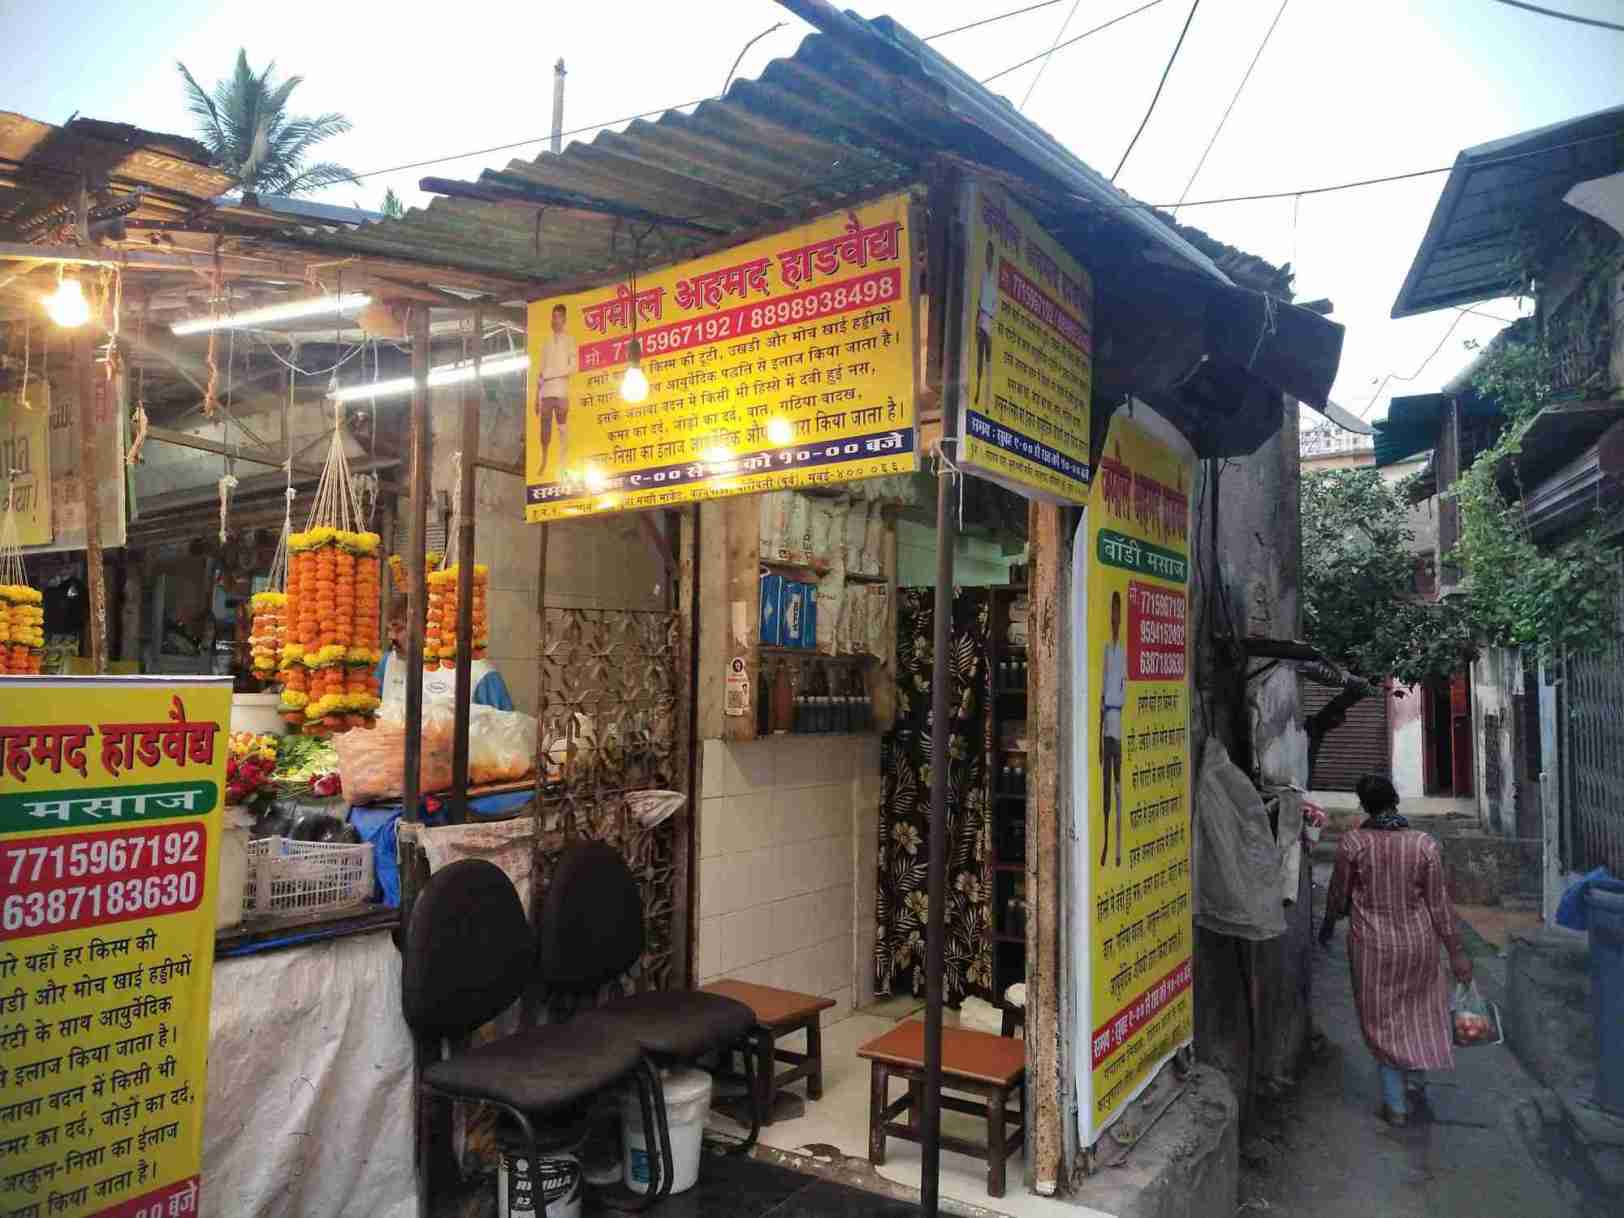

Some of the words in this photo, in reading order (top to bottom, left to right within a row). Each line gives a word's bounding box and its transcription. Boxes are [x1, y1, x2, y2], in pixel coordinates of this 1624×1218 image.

[674, 258, 773, 310] अहमद
[751, 276, 894, 329] 8898938498
[767, 332, 787, 348] और
[792, 326, 817, 342] मोच
[808, 345, 840, 361] किया
[845, 336, 877, 353] जाता
[851, 405, 882, 425] जाता
[866, 432, 904, 453] बजे
[1103, 534, 1142, 566] बॉडी
[1144, 549, 1185, 577] मसाज
[23, 789, 203, 821] मसाज
[7, 830, 199, 884] 7715967192
[3, 871, 196, 931] 6387183630
[25, 943, 58, 972] यहाँ
[64, 946, 84, 968] हर
[90, 937, 131, 961] किस्म
[136, 928, 157, 951] की
[34, 979, 67, 1006] और
[73, 973, 108, 998] मोच
[112, 963, 144, 991] खाई
[34, 1018, 53, 1044] के
[58, 1013, 93, 1037] साथ
[99, 993, 172, 1030] आयुर्वेदिक
[15, 1056, 63, 1088] इलाज
[68, 1044, 111, 1071] किया
[116, 1032, 153, 1057] जाता
[91, 1072, 105, 1097] में
[111, 1061, 152, 1093] किसी
[158, 1054, 177, 1078] भी
[35, 1125, 60, 1147] का
[64, 1110, 93, 1137] दर्द,
[144, 1092, 166, 1112] का
[111, 1135, 133, 1156] का
[48, 1186, 89, 1215] किया
[94, 1170, 133, 1197] जाता
